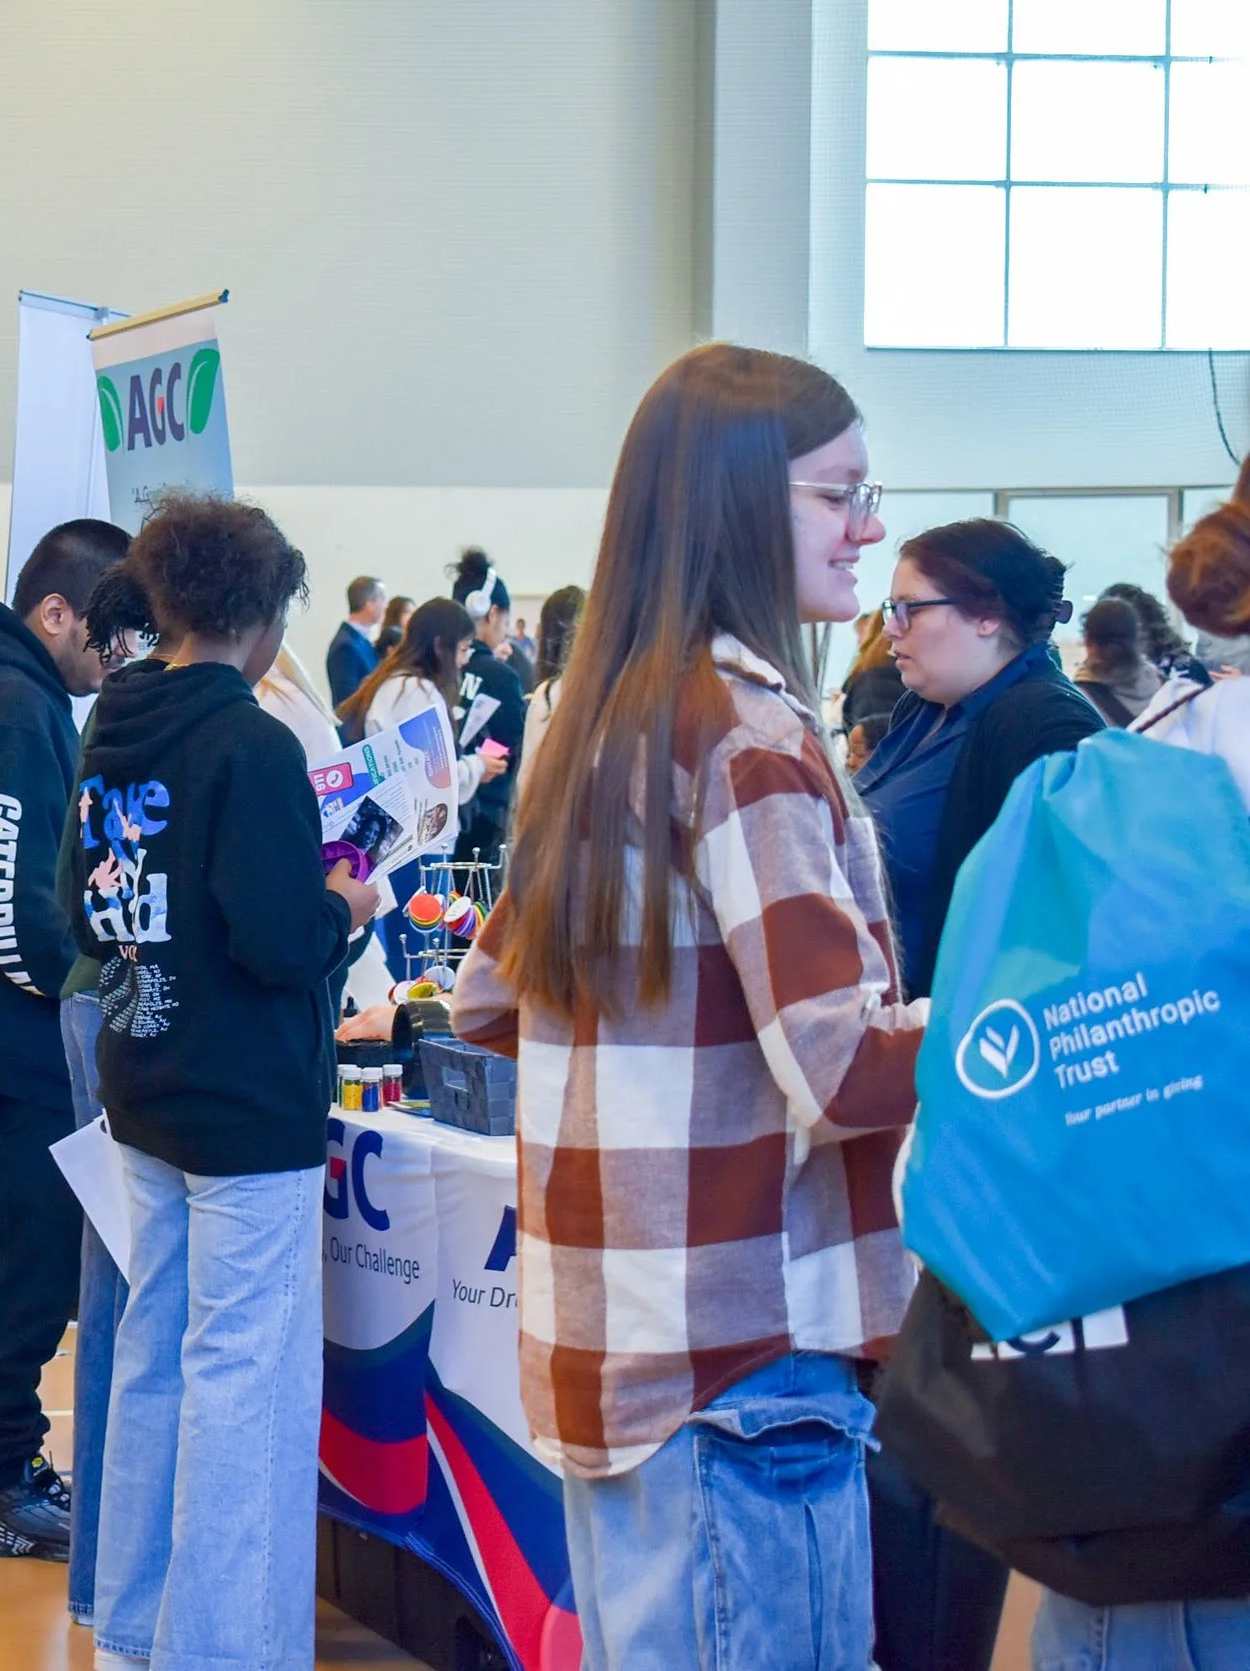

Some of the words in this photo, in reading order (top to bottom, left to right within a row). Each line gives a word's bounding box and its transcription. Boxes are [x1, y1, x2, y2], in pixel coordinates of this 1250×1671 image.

[127, 362, 186, 451] AGC
[1043, 971, 1148, 1030] National
[1049, 990, 1221, 1060] Philanthropic
[1054, 1050, 1120, 1088] Trust
[1064, 1107, 1092, 1127] Your
[1095, 1092, 1142, 1121] partner
[1146, 1087, 1159, 1102] in
[1163, 1074, 1204, 1100] giving
[323, 1118, 390, 1231] GC
[330, 1236, 352, 1264] Our
[355, 1243, 420, 1285] Challenge
[452, 1279, 486, 1305] Your
[490, 1287, 517, 1308] Dr
